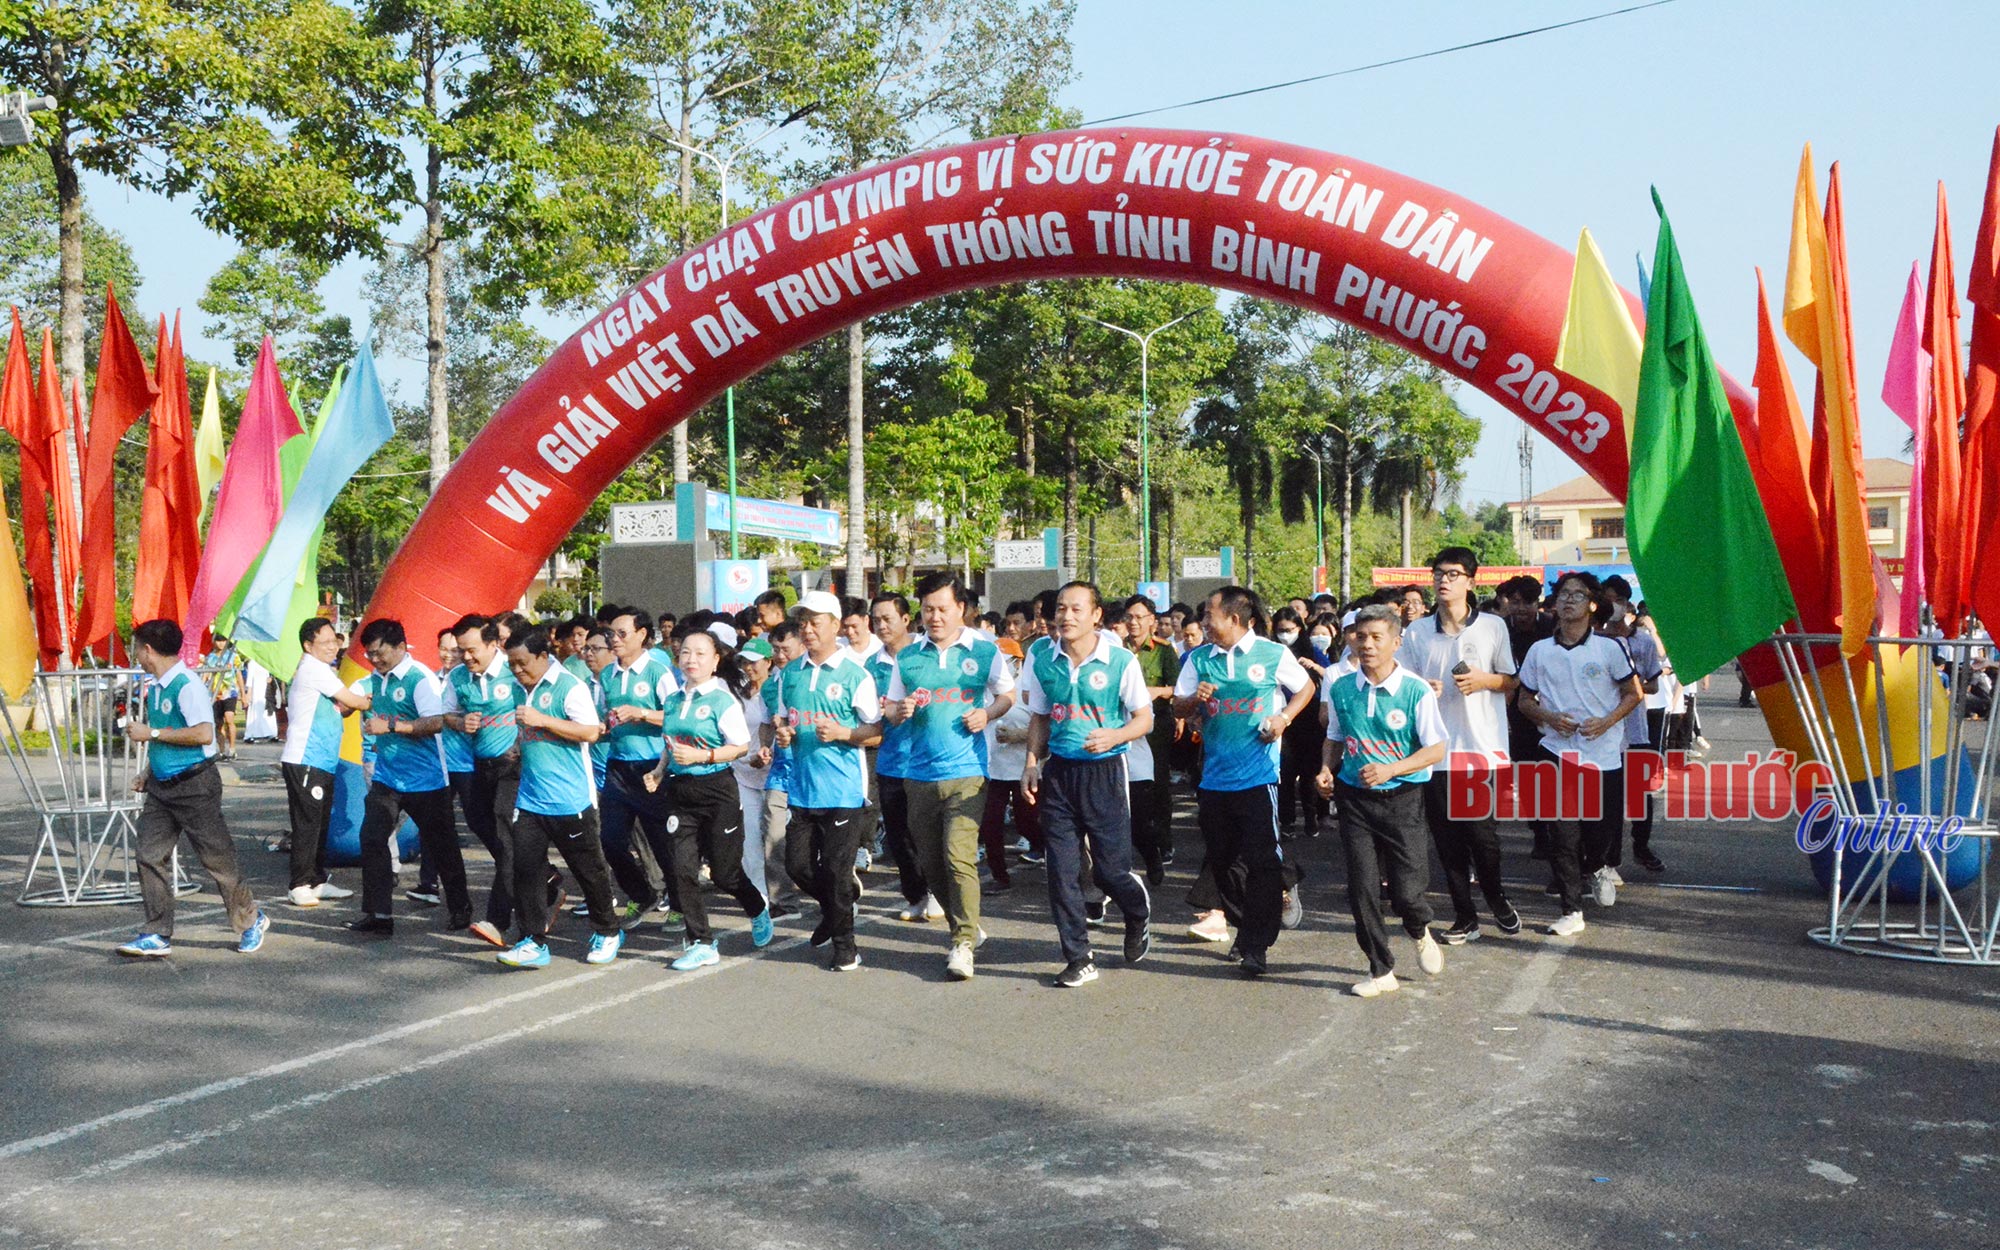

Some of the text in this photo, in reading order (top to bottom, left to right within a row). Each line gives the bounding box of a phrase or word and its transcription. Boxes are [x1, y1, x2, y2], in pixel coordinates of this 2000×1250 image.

[683, 213, 777, 292] CHẠY
[788, 156, 962, 242] OLYMPIC
[977, 139, 1016, 191] VÌ
[1025, 135, 1117, 185] SỨC
[1123, 137, 1250, 196] KHỎE
[1256, 158, 1384, 233] TOÀN
[1380, 201, 1494, 283] DÂN
[485, 193, 1610, 524] VÀ GIẢI VIỆT DÃ TRUYỀN THỐNG TỈNH BÌNH PHƯỚC 2023
[935, 687, 974, 704] SCG
[1223, 697, 1264, 714] SCG
